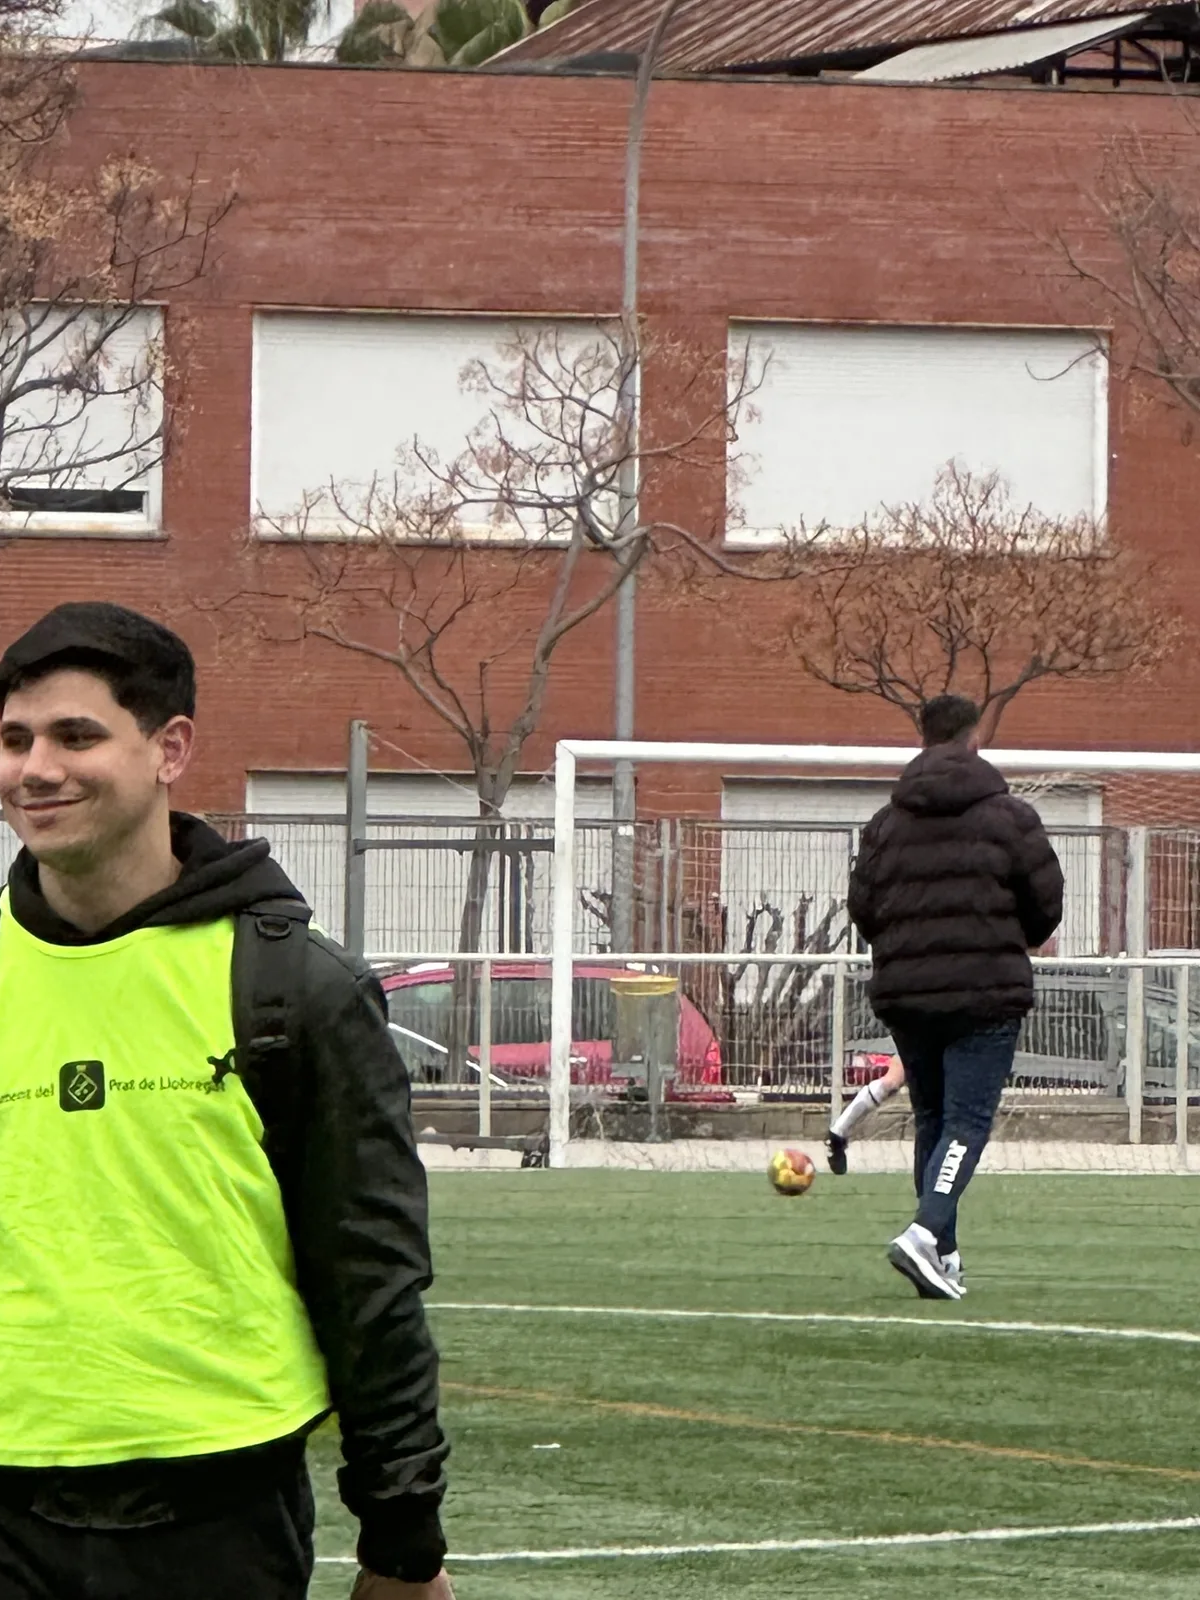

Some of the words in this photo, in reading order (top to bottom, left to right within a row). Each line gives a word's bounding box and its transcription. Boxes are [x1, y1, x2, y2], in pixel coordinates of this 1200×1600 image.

[35, 1083, 54, 1099] del
[108, 1079, 135, 1091] Prat
[139, 1077, 155, 1090] de
